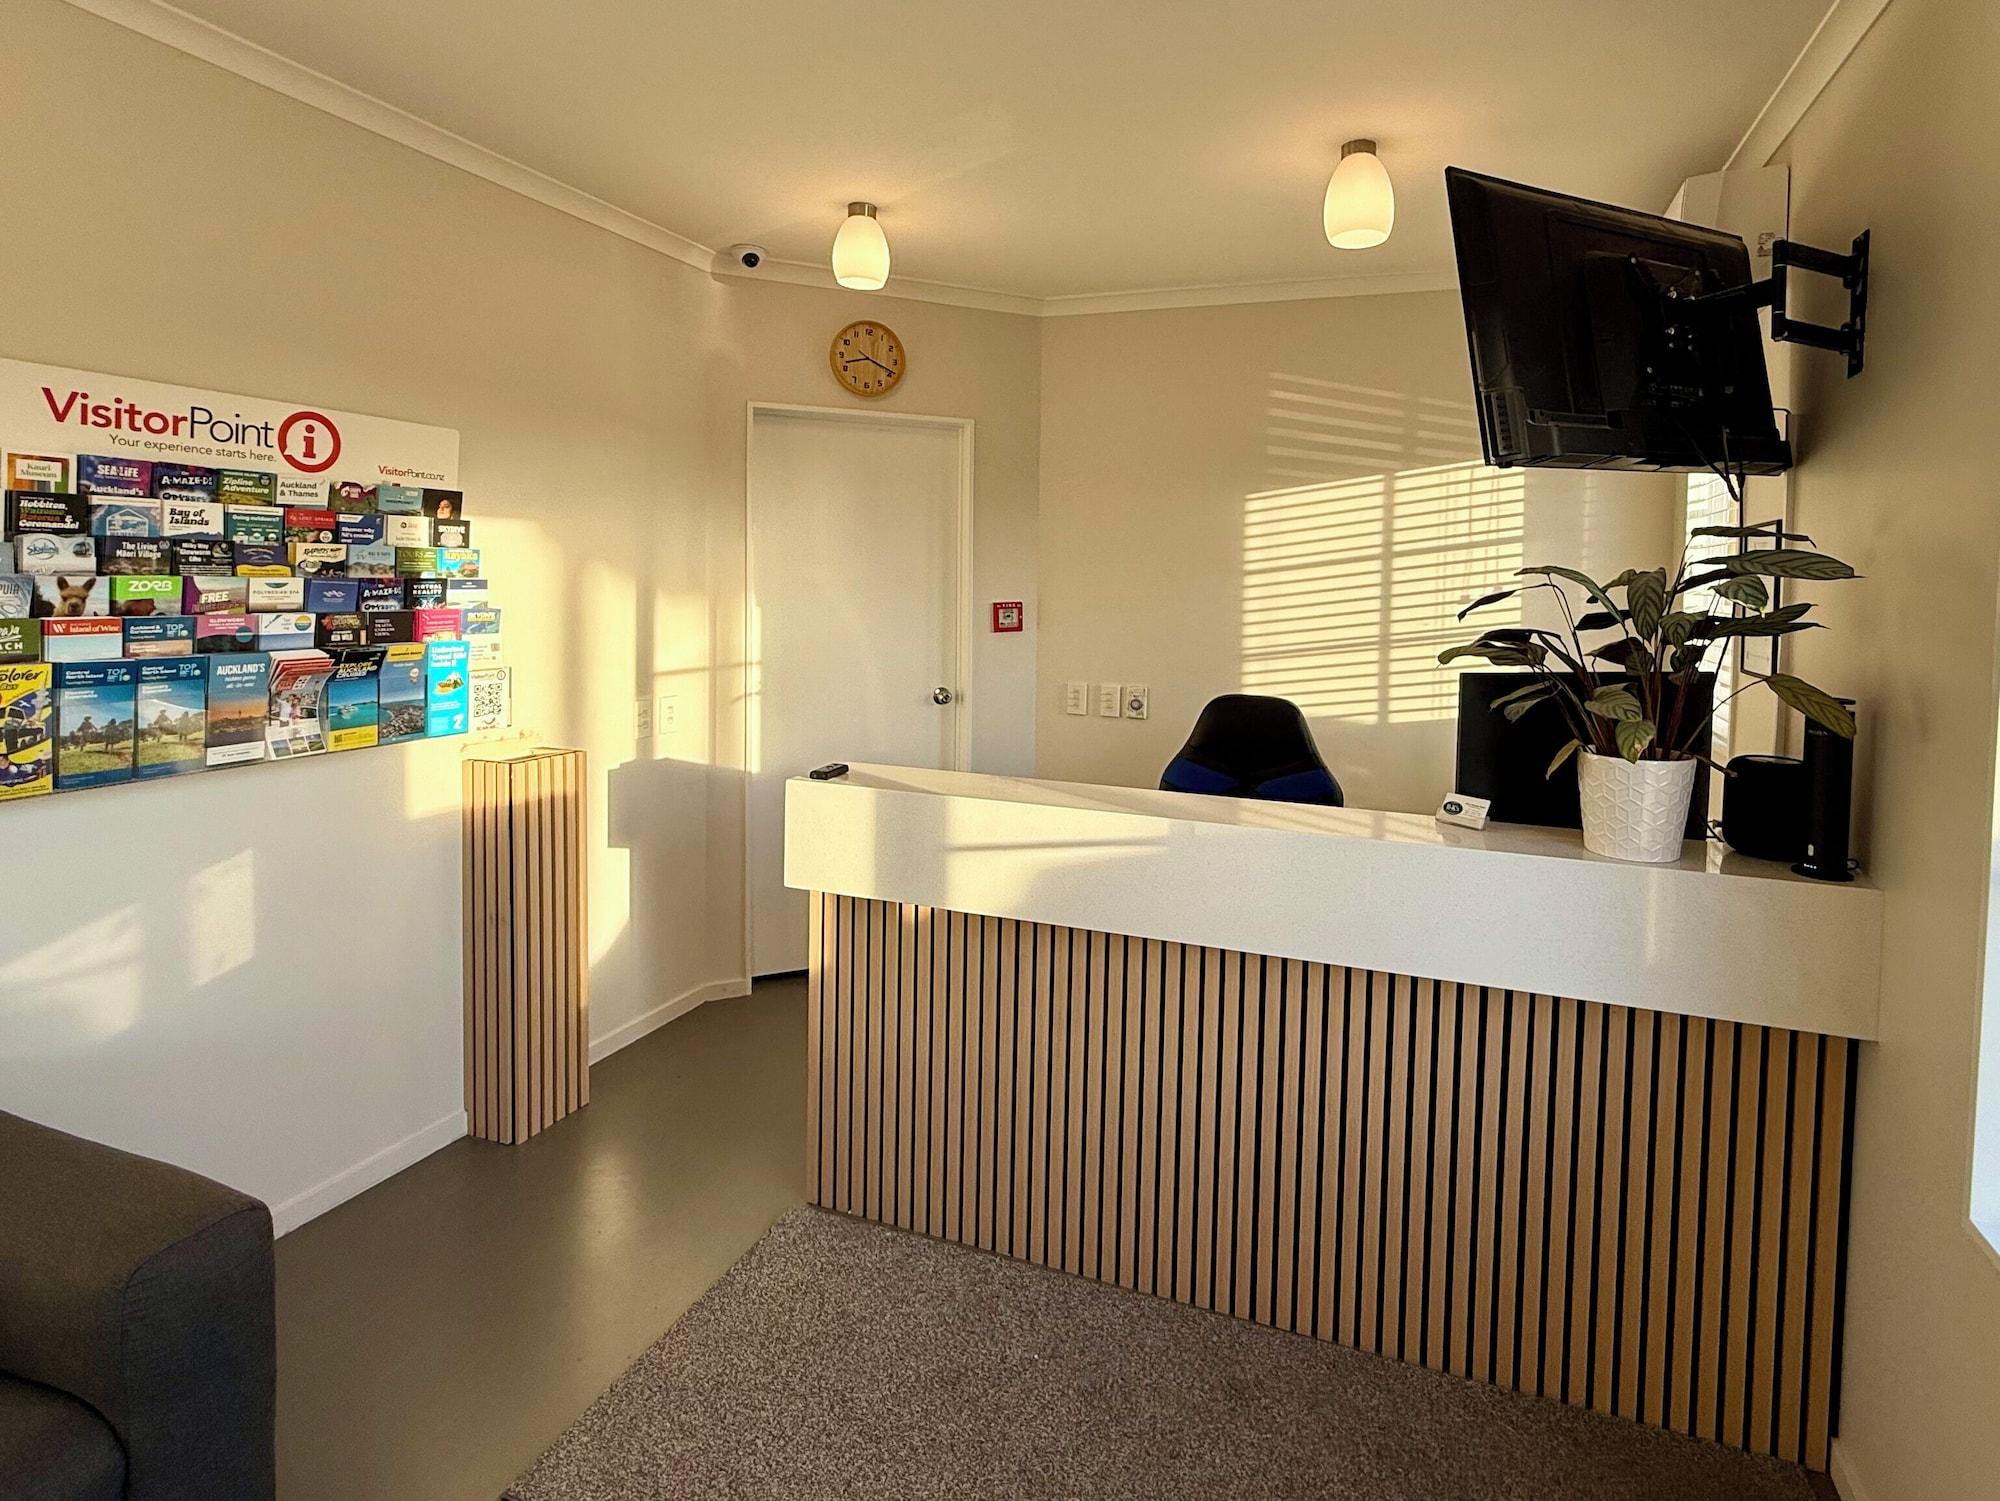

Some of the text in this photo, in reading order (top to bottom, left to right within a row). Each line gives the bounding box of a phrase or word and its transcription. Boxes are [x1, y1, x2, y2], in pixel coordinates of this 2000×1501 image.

[866, 328, 873, 336] 12
[852, 376, 857, 384] 7
[41, 386, 274, 448] VisitorPoint
[109, 433, 277, 463] Your experience starts here.
[378, 465, 445, 481] VisitorPoint.co.nz
[222, 477, 254, 487] Zipline
[280, 481, 317, 490] Auckland
[89, 484, 144, 496] Auckland's
[222, 484, 270, 494] Adventure
[288, 490, 319, 498] Thames
[169, 508, 206, 518] Bay of
[19, 520, 80, 530] Coromandel
[168, 516, 210, 527] Islands
[122, 541, 158, 552] The Living
[138, 549, 162, 560] Village
[128, 580, 173, 592] ZORB
[201, 591, 230, 604] FREE
[69, 624, 120, 633] Island of Wine
[216, 663, 266, 676] AUCKLAND'S
